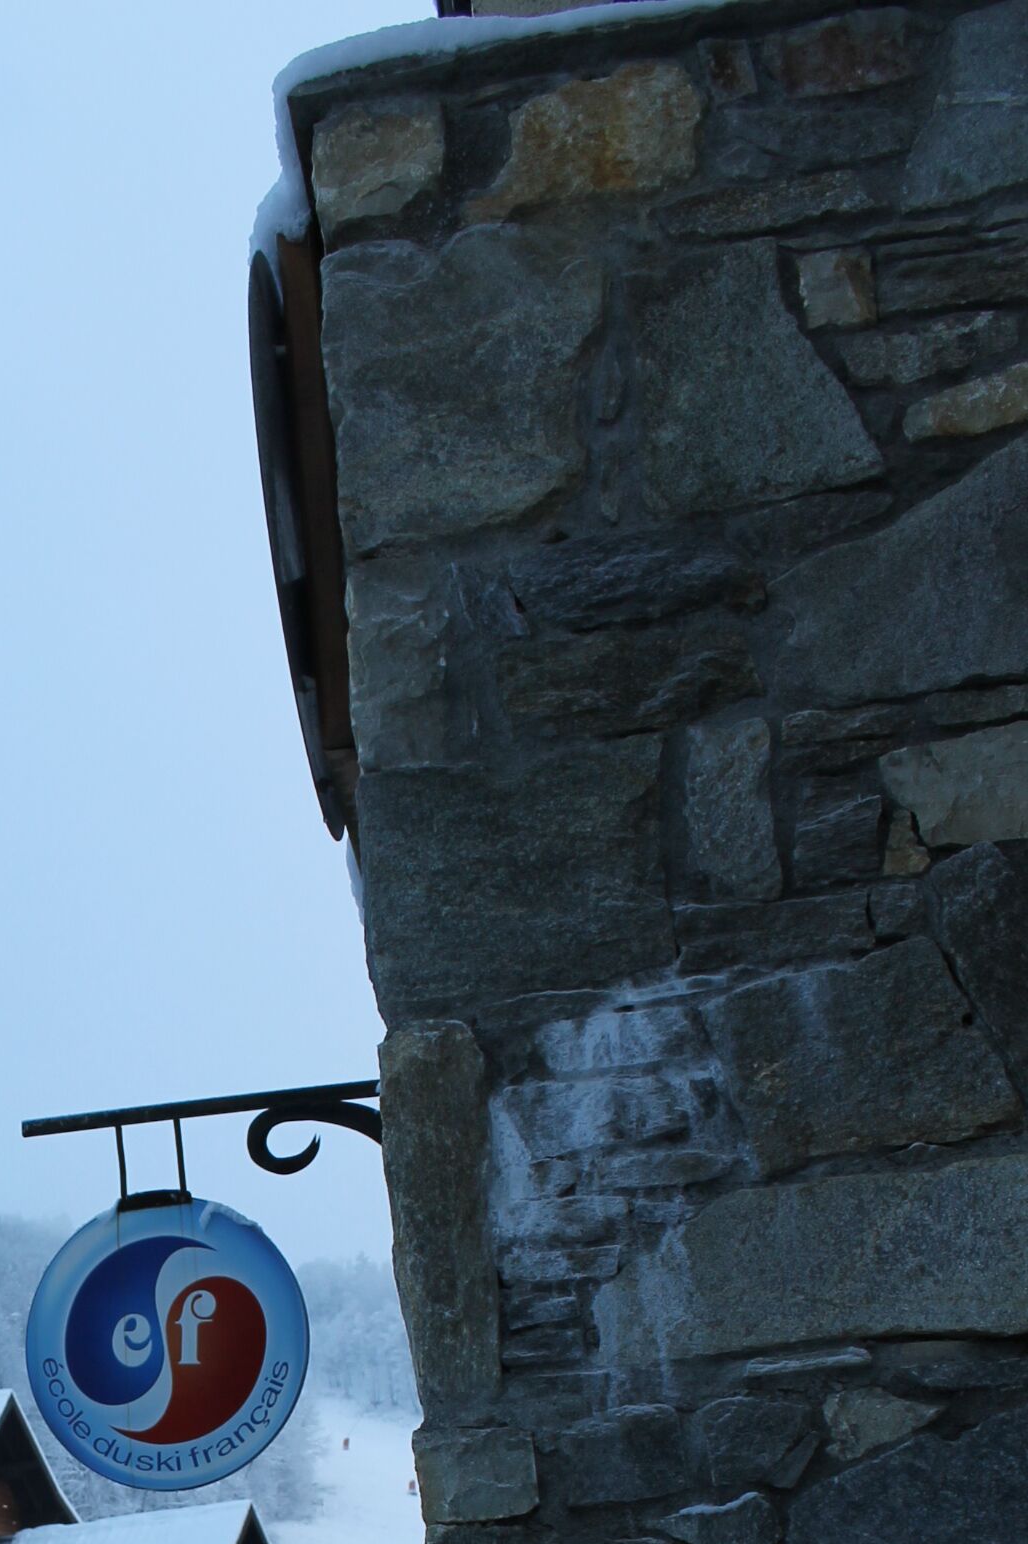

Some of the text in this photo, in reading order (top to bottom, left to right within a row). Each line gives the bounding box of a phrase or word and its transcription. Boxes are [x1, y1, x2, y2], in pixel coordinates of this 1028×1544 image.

[42, 1357, 289, 1472] école du ski français
